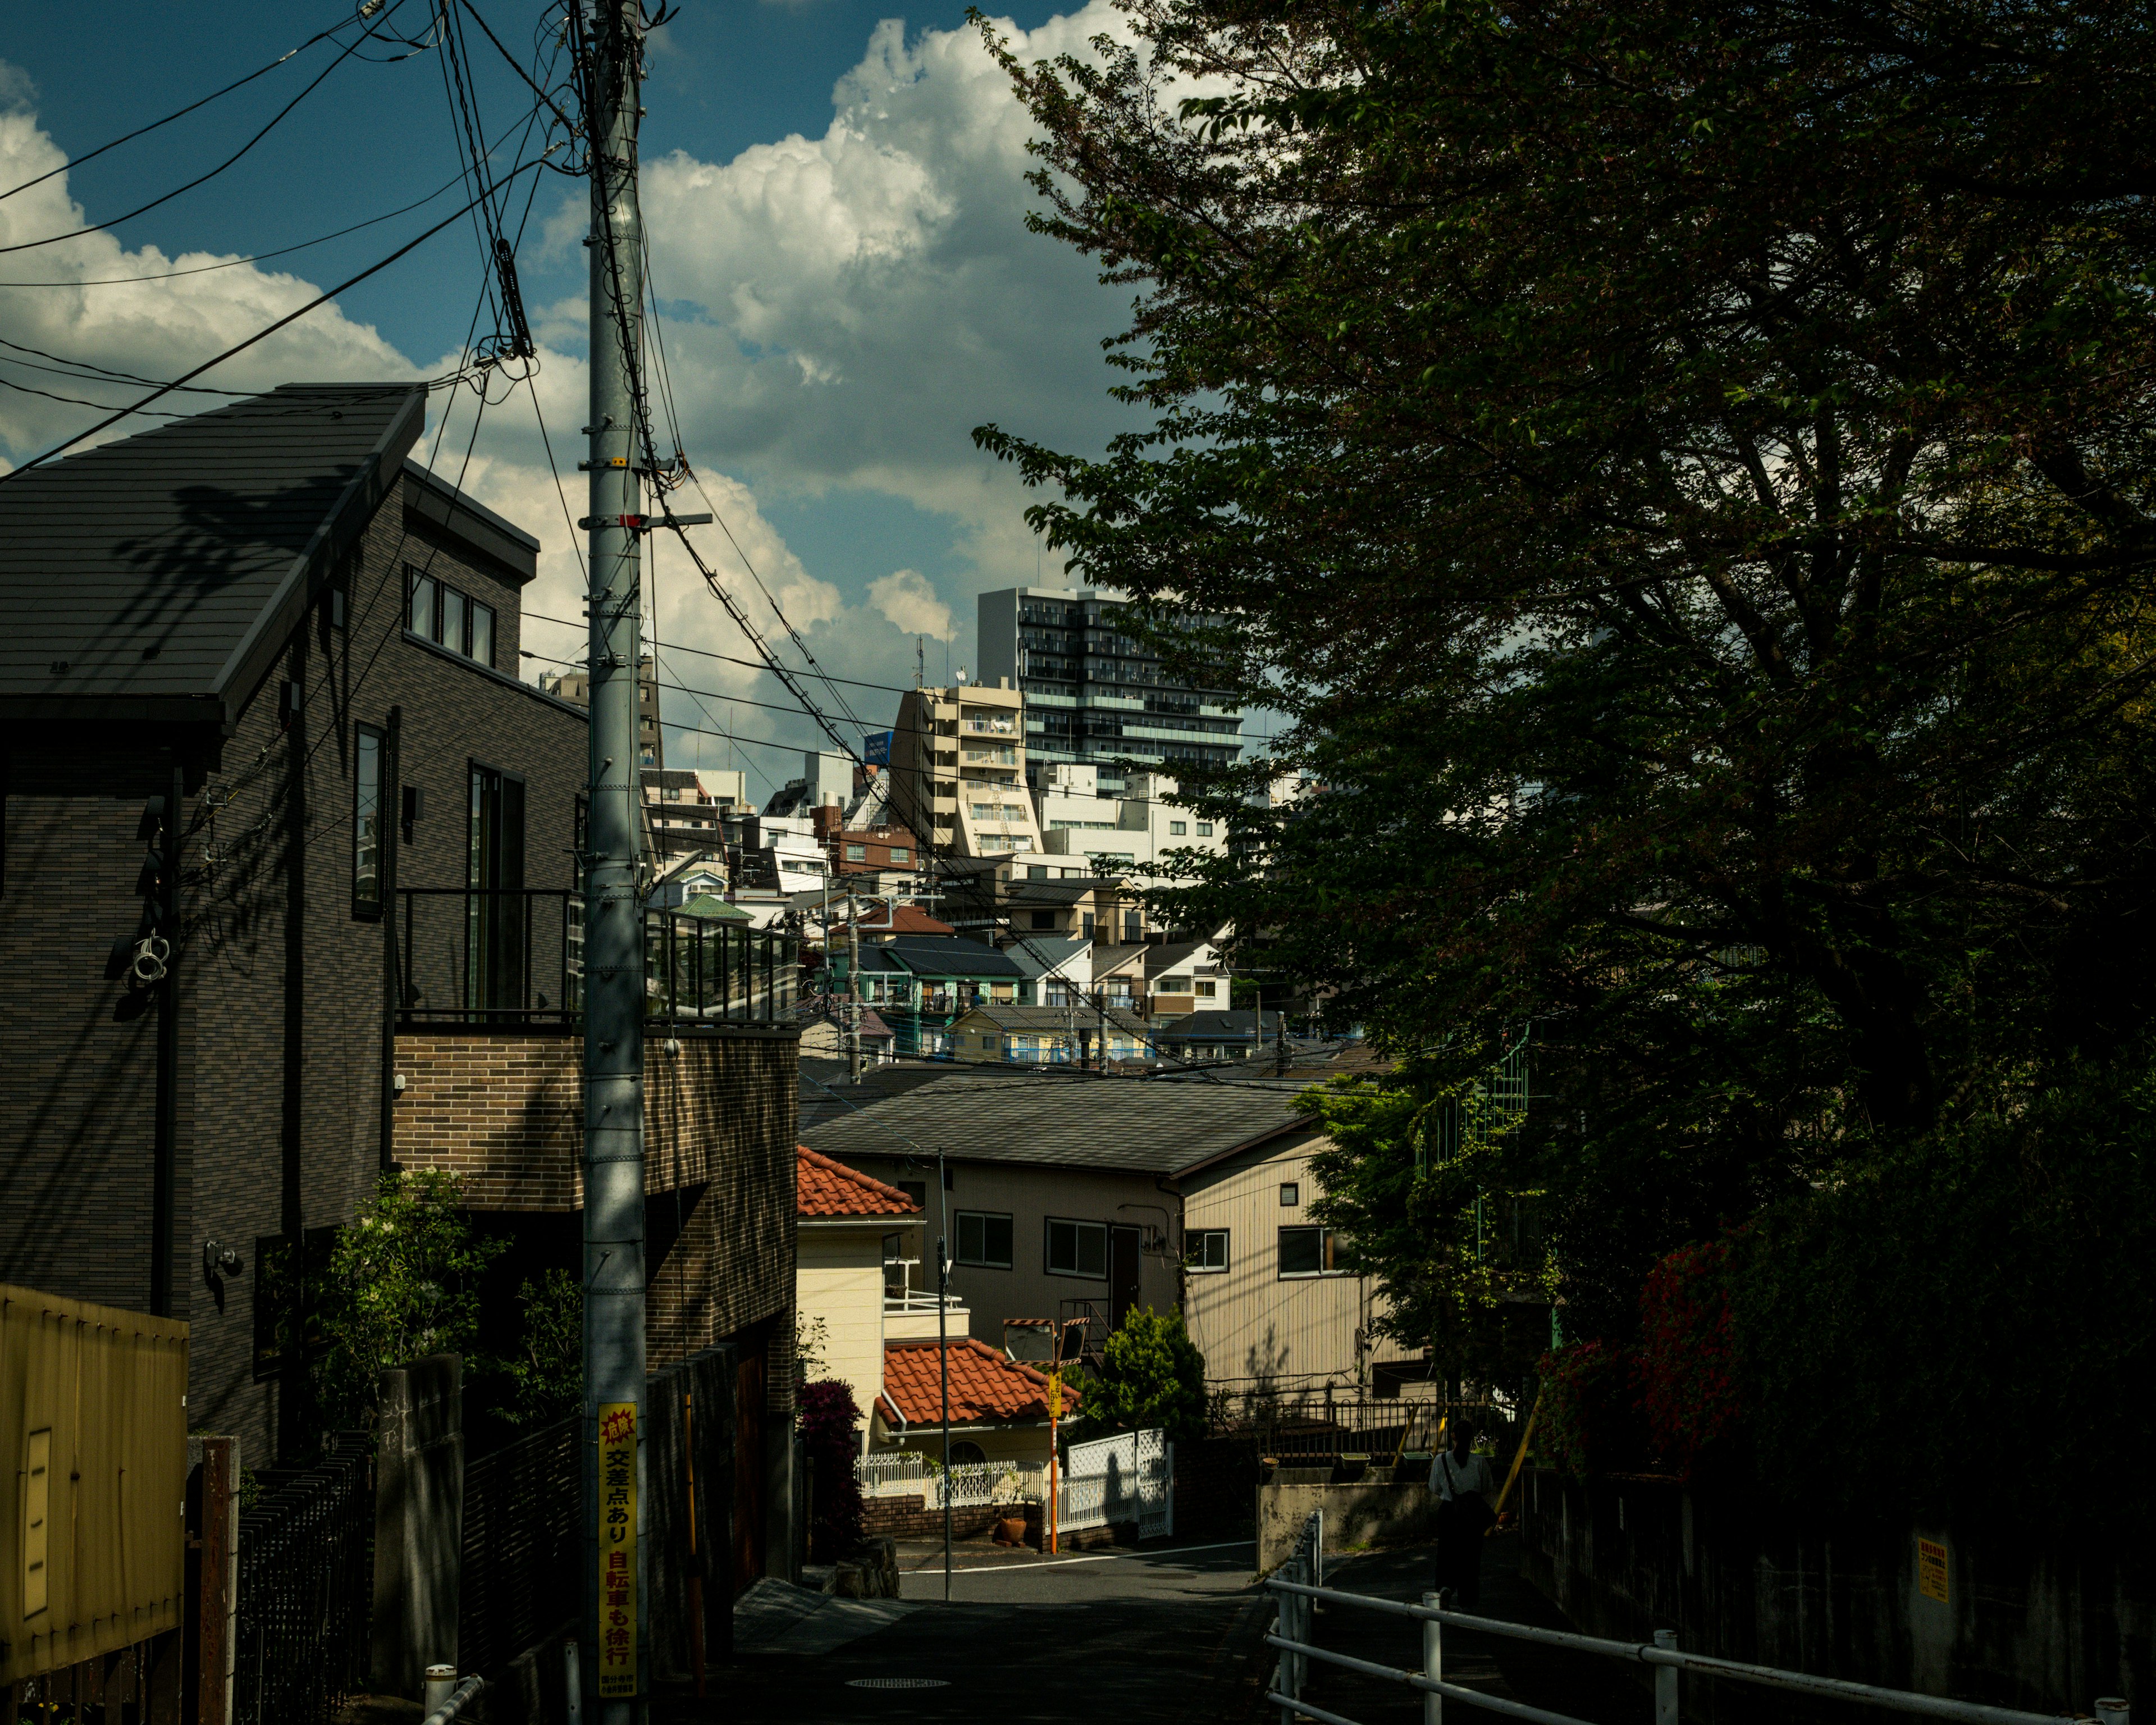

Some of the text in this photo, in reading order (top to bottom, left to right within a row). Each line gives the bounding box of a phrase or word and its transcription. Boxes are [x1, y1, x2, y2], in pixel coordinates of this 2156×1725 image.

[607, 1416, 630, 1439] 危険
[606, 1449, 629, 1543] 交差点あり
[606, 1551, 629, 1665] 自転車も徐行
[601, 1675, 634, 1683] 国分寺市
